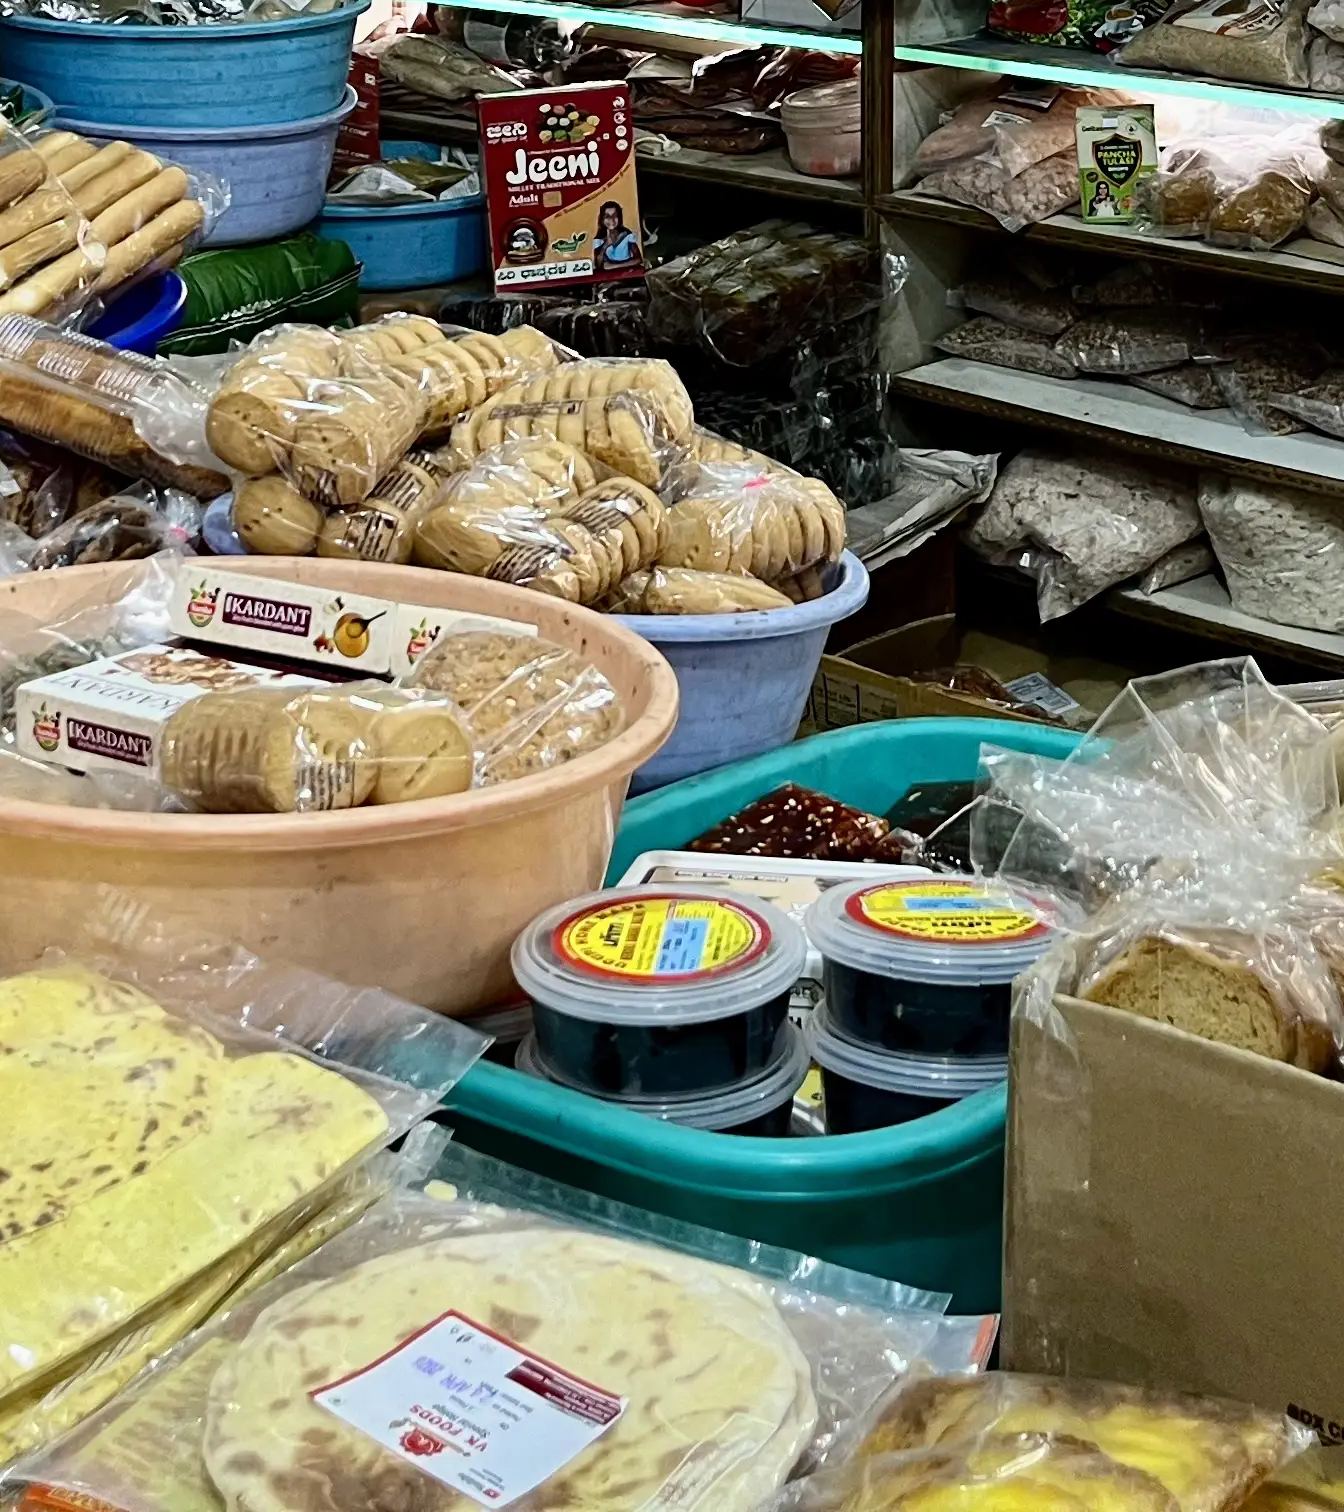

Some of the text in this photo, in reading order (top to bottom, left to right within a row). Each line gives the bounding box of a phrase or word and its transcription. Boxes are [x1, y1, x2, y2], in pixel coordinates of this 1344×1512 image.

[1097, 149, 1137, 159] PANCHA
[1102, 156, 1135, 166] TULASI
[506, 140, 600, 185] Jeeni
[509, 192, 539, 206] Adult
[408, 1403, 464, 1438] FOODS
